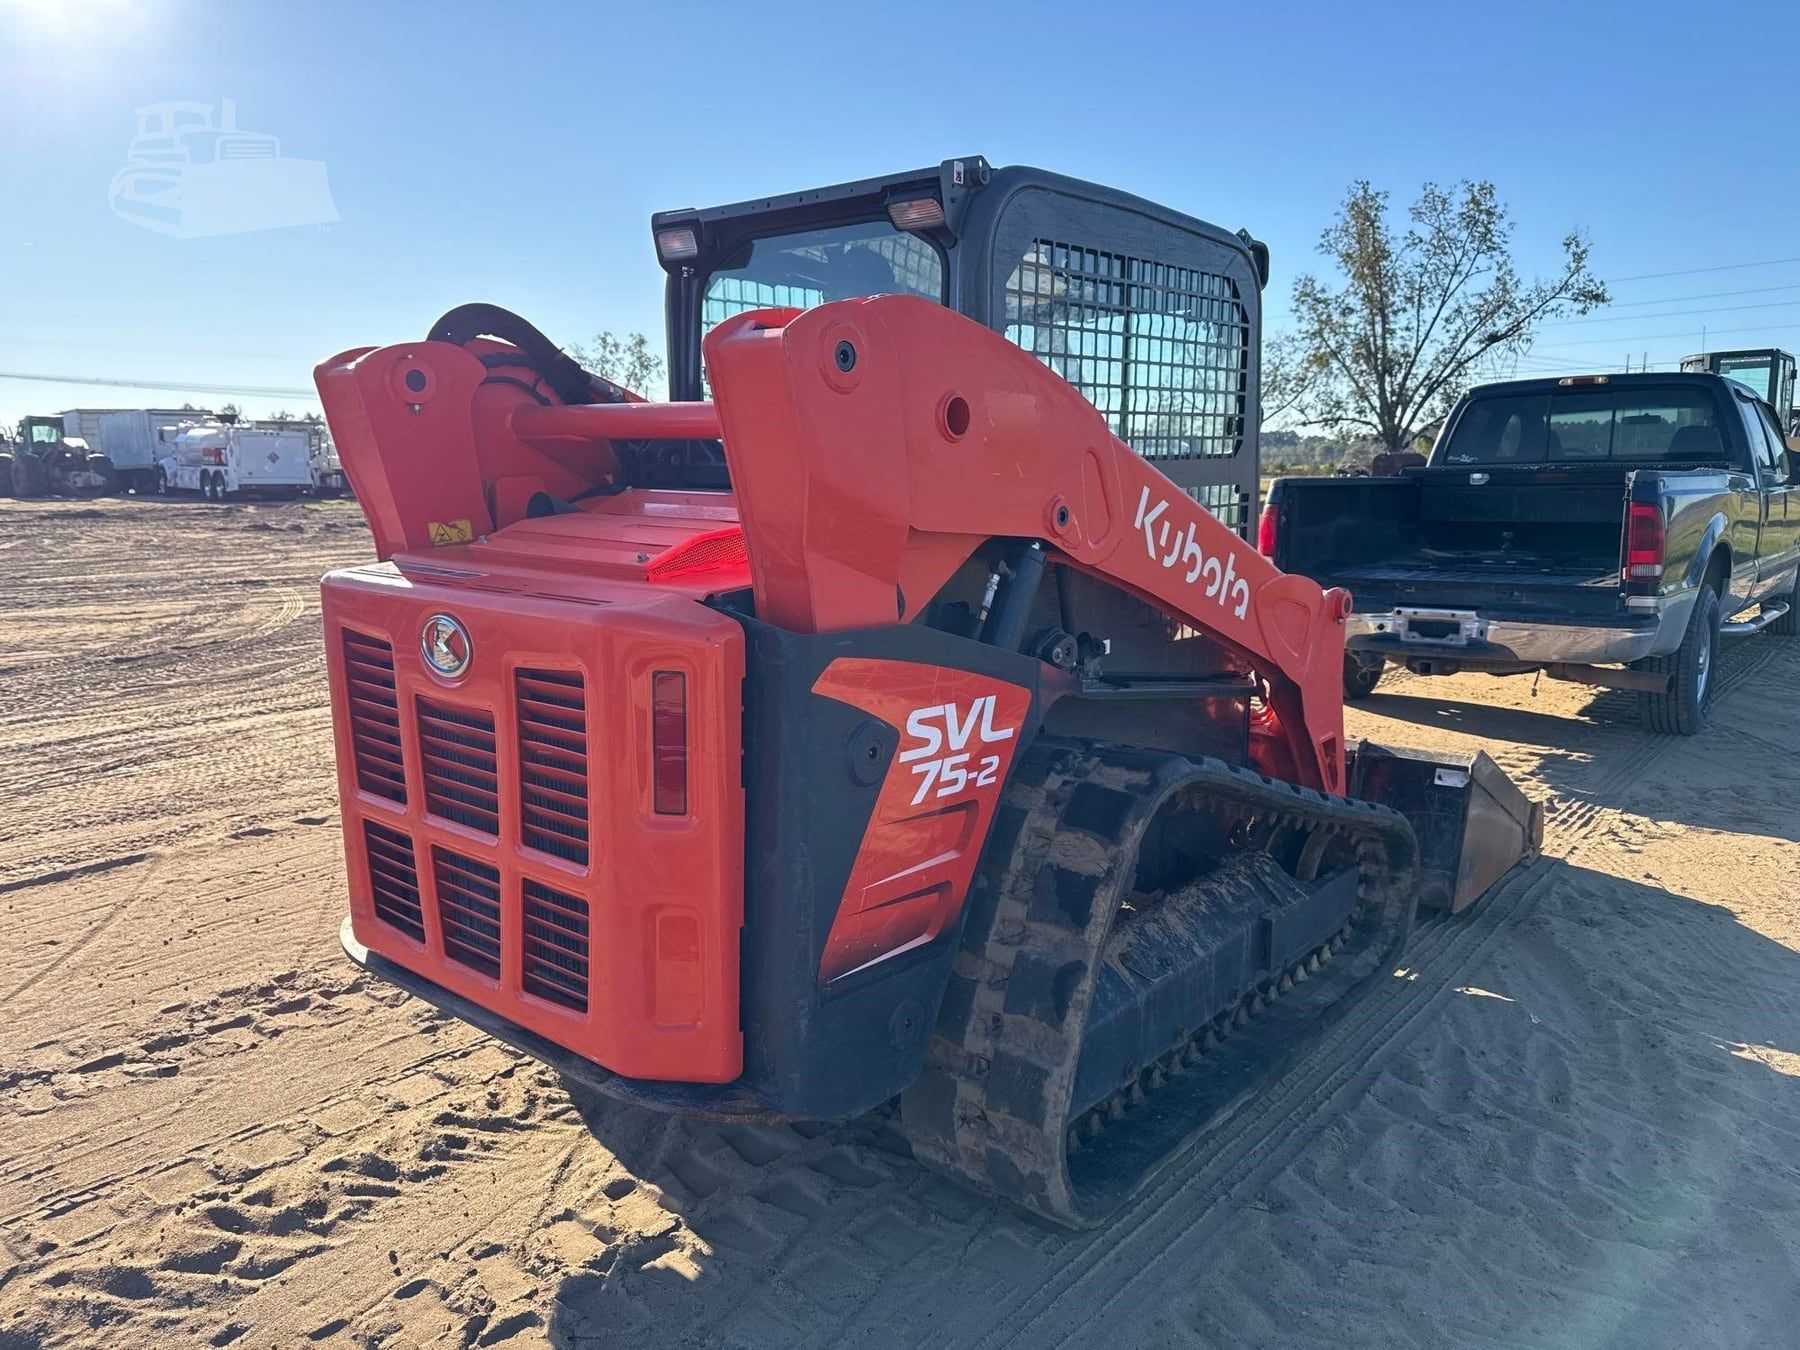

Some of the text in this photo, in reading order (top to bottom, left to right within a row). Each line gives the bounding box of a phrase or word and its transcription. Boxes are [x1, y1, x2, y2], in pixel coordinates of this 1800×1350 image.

[1134, 485, 1249, 620] Kubota
[899, 695, 1014, 763] SVL
[911, 753, 1000, 806] 75-2
